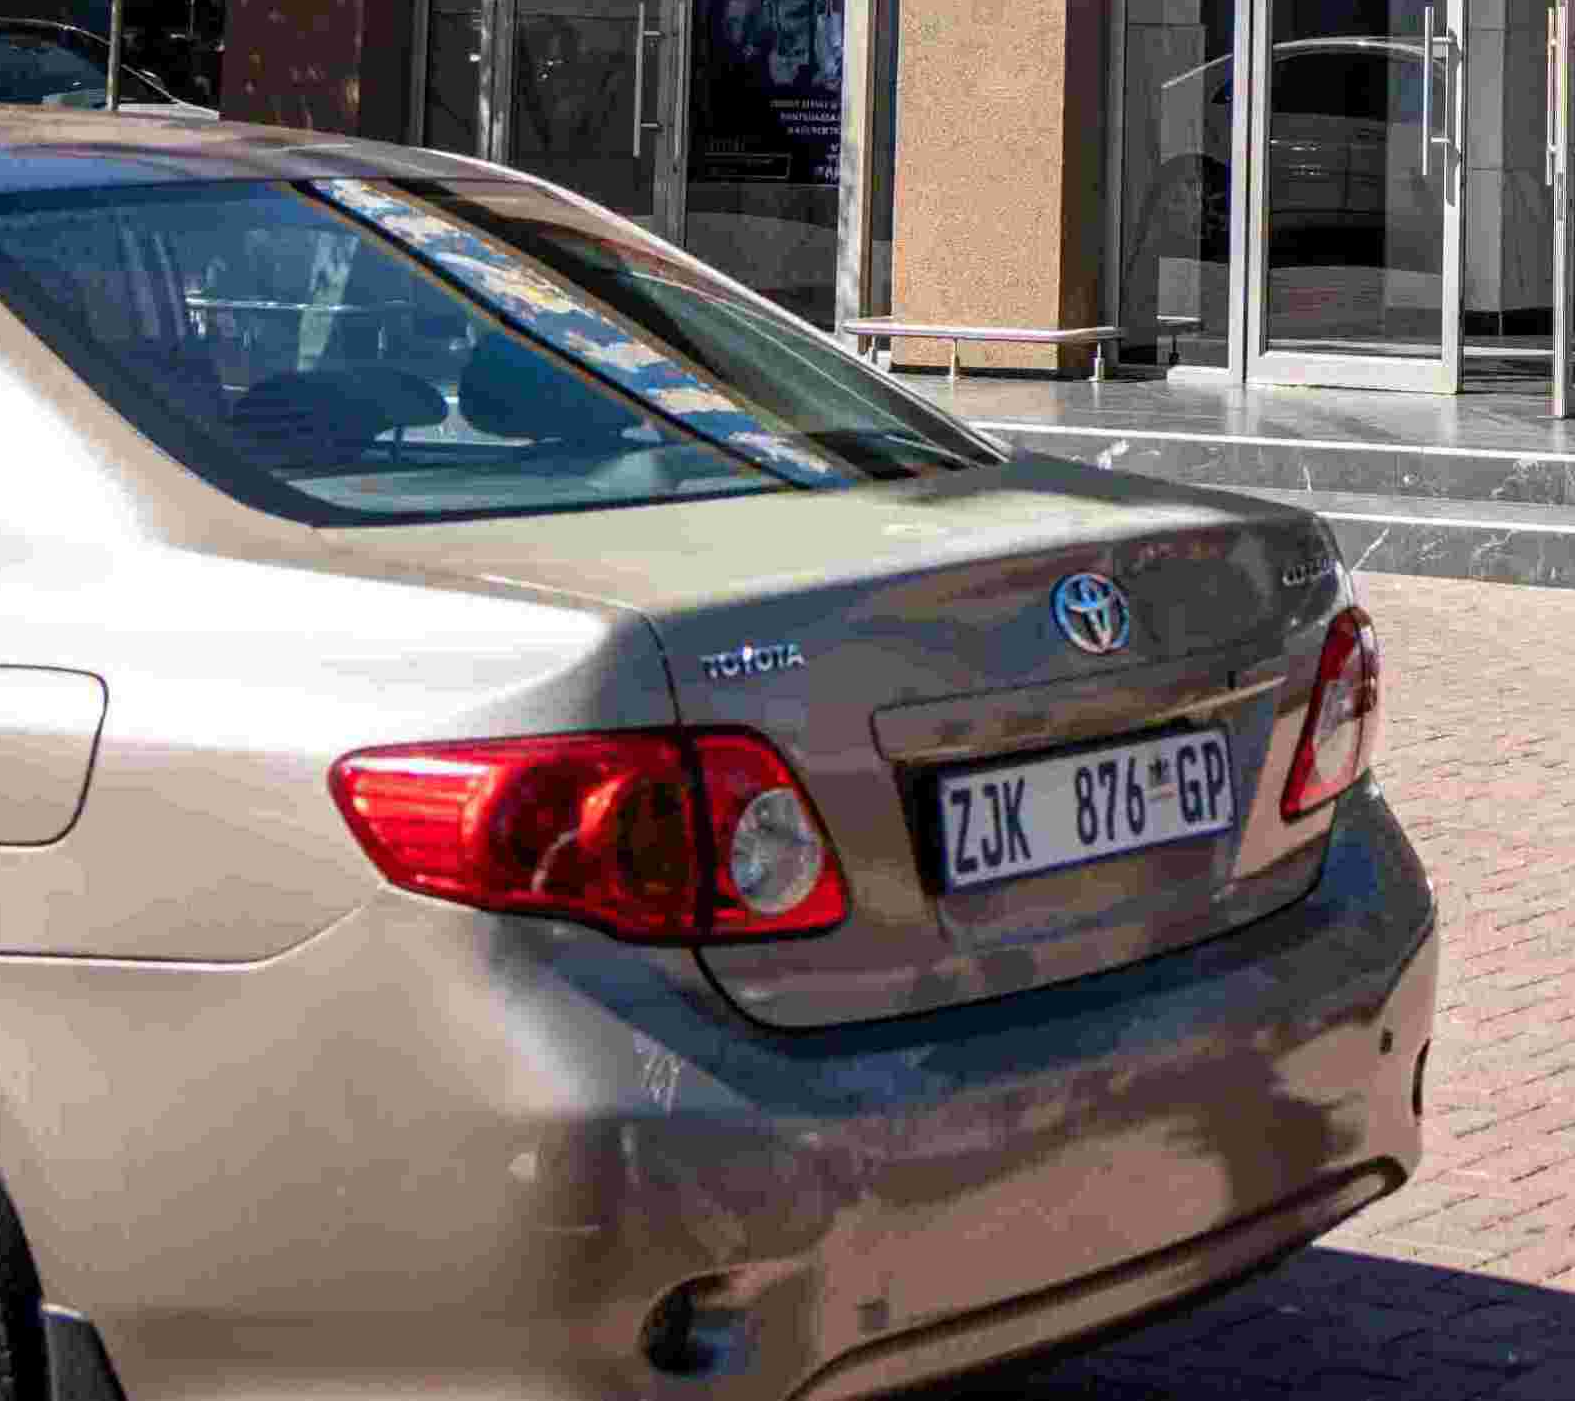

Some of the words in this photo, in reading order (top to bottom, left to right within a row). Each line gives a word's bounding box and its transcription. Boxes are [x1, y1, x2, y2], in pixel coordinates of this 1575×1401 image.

[699, 643, 806, 678] TOYOTA
[951, 776, 1032, 875] ZJK
[1074, 755, 1146, 847] 876
[1176, 736, 1225, 826] GP
